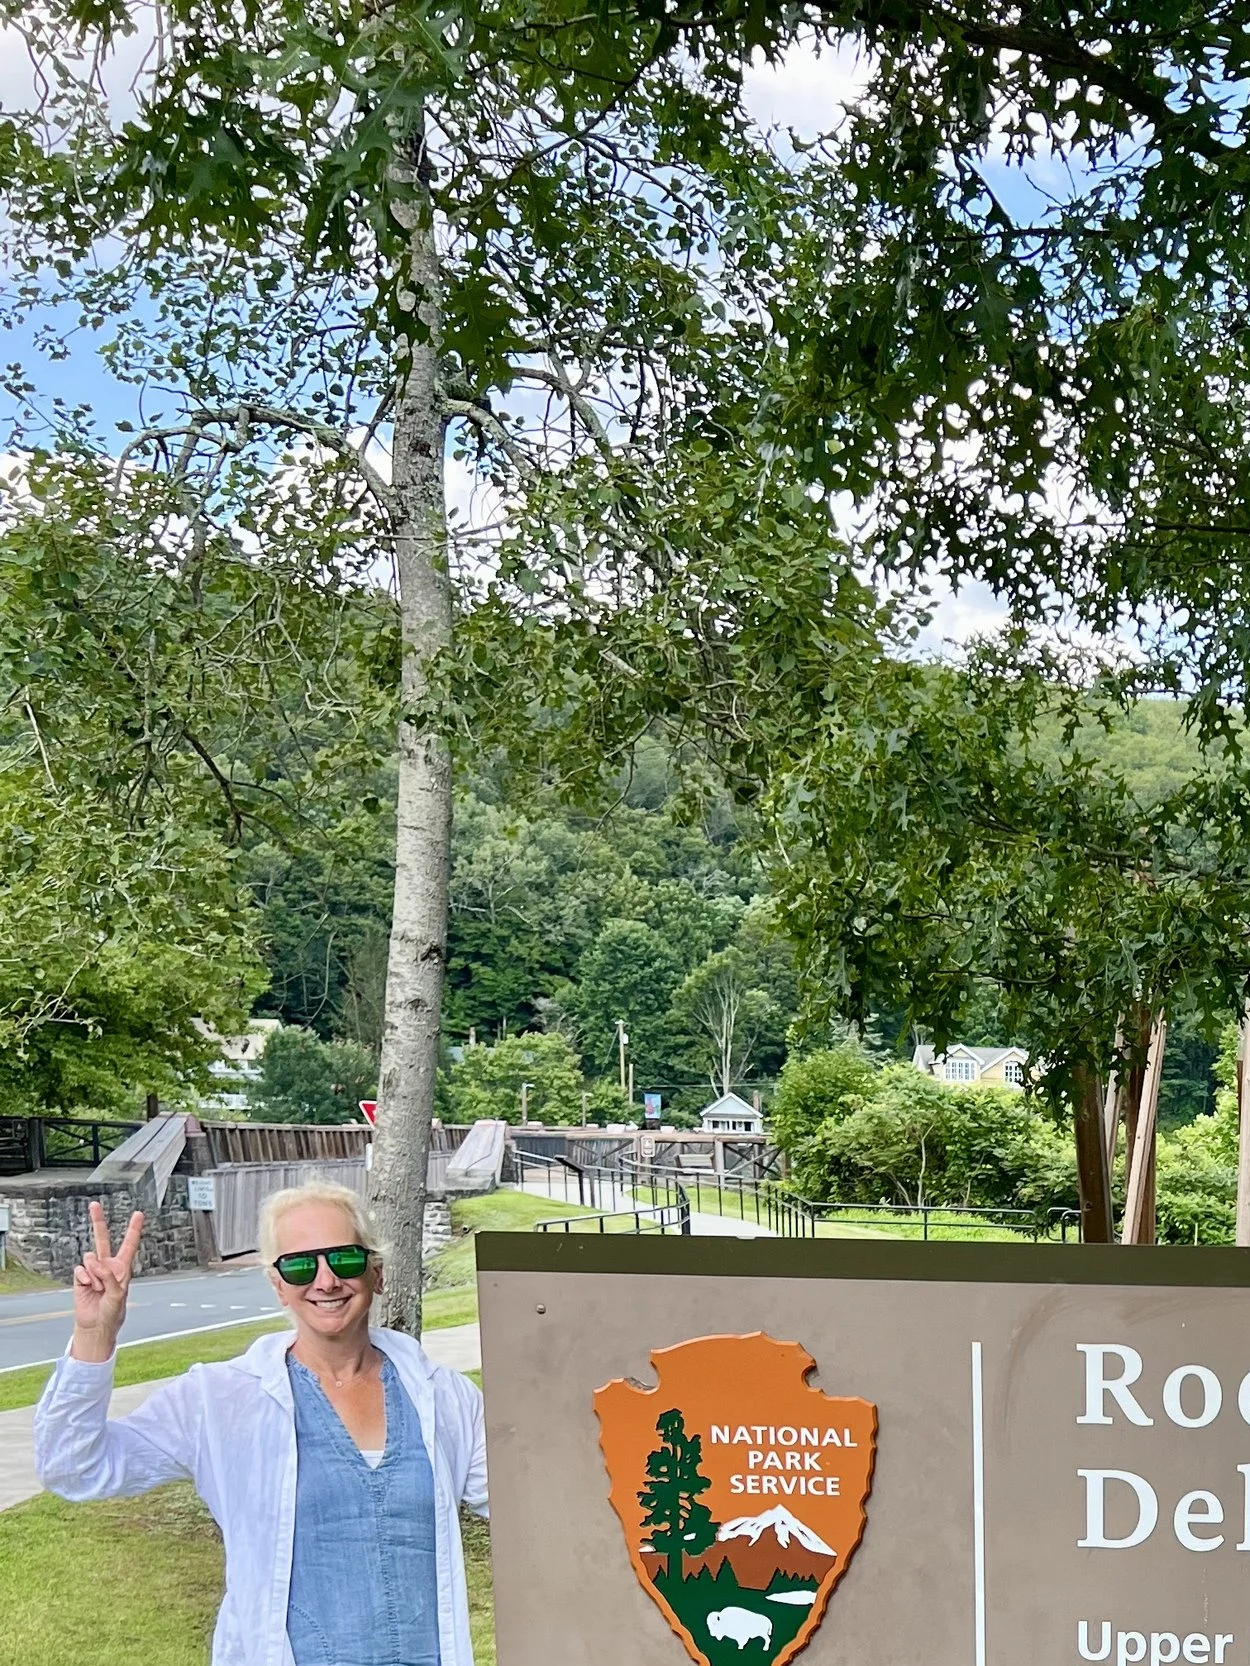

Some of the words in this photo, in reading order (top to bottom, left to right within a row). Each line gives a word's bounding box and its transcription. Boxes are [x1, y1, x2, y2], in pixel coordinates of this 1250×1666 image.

[711, 1424, 858, 1447] NATIONAL
[748, 1450, 822, 1471] PARK
[730, 1474, 840, 1496] SERVICE
